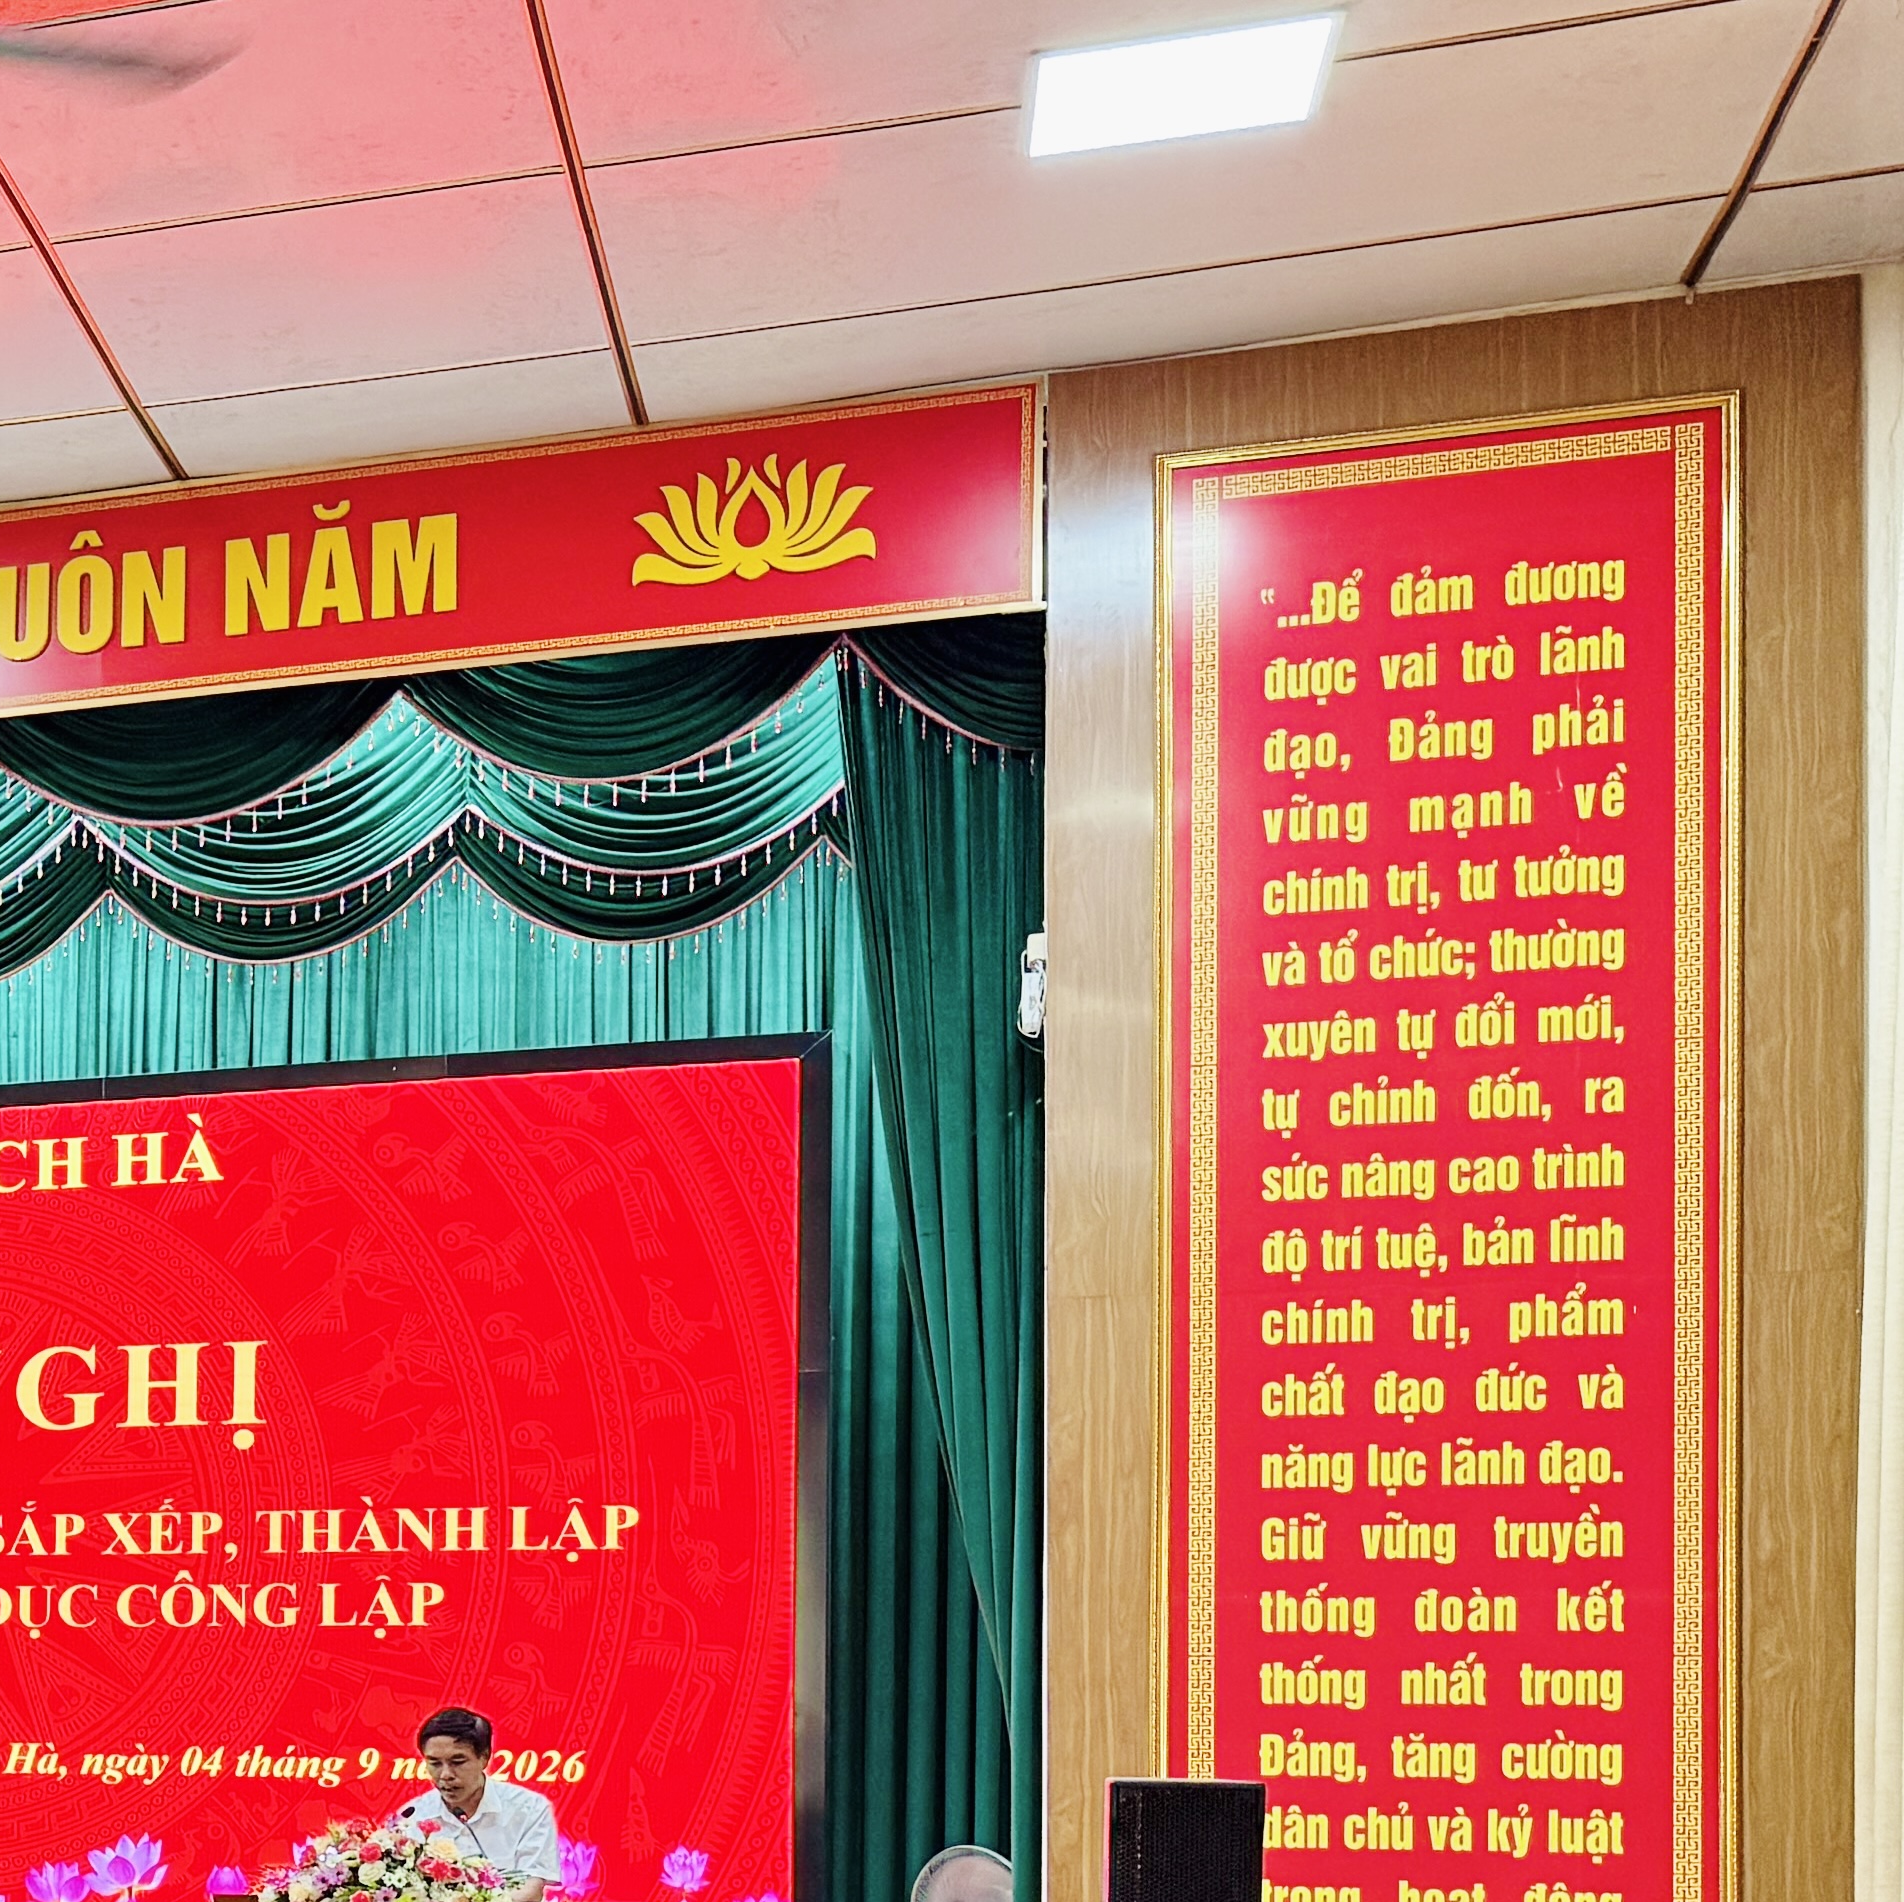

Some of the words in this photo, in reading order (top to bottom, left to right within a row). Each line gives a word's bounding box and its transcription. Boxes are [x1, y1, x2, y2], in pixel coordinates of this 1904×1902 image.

[224, 499, 458, 637] NĂM
[1390, 565, 1474, 618] đảm
[1504, 559, 1625, 606] đương
[1264, 656, 1357, 706] được
[1379, 642, 1437, 690] vai
[1461, 634, 1514, 683] trò
[1540, 625, 1625, 676] lãnh
[1263, 728, 1351, 780] đạo,
[1388, 709, 1493, 762] Đảng
[1532, 694, 1624, 756] phải
[1262, 793, 1368, 844] vững
[1409, 781, 1532, 839] mạnh
[1573, 762, 1628, 820] về
[1263, 866, 1369, 916] chính
[1385, 861, 1441, 915] trị,
[1458, 859, 1499, 902] tư
[1513, 844, 1625, 898] tưởng
[1262, 1009, 1376, 1062] xuyên
[1396, 1008, 1437, 1060] tự
[1455, 991, 1515, 1048] đổi
[1537, 993, 1625, 1044] mới,
[1261, 1088, 1300, 1139] tự
[1329, 1075, 1436, 1127] chỉnh
[1468, 1066, 1552, 1122] đốn,
[1585, 1076, 1625, 1114] ra
[111, 1112, 224, 1187] HÀ
[1262, 1228, 1307, 1282] độ
[1320, 1225, 1363, 1272] trí
[1375, 1222, 1448, 1278] tuệ,
[1462, 1215, 1534, 1266] bản
[1550, 1213, 1624, 1263] lĩnh
[1261, 1299, 1374, 1346] chính
[1410, 1296, 1470, 1350] trị,
[1509, 1281, 1624, 1344] phẩm
[1261, 1443, 1354, 1494] năng
[1367, 1443, 1427, 1497] lực
[1441, 1437, 1525, 1486] lãnh
[1539, 1440, 1624, 1494] đạo.
[102, 1498, 238, 1563] XẾP,
[255, 1496, 488, 1554] THÀNH
[510, 1497, 639, 1563] LẬP
[116, 1569, 300, 1628] CÔNG
[320, 1575, 445, 1639] LẬP
[1259, 1582, 1375, 1638] thống
[1414, 1586, 1517, 1633] đoàn
[1557, 1580, 1625, 1632] kết
[1259, 1654, 1366, 1710] thống
[1401, 1651, 1487, 1706] nhất
[1519, 1663, 1623, 1712] trong
[3, 1742, 68, 1781] Hà,
[80, 1743, 170, 1786] ngày
[180, 1745, 225, 1778] 04
[235, 1744, 347, 1788] tháng
[357, 1747, 380, 1779] 9
[493, 1748, 587, 1783] 2026
[1262, 1804, 1329, 1849] dân
[1343, 1801, 1414, 1851] chủ
[1427, 1806, 1473, 1852] và
[1487, 1803, 1533, 1859] kỷ
[1548, 1808, 1624, 1864] luật
